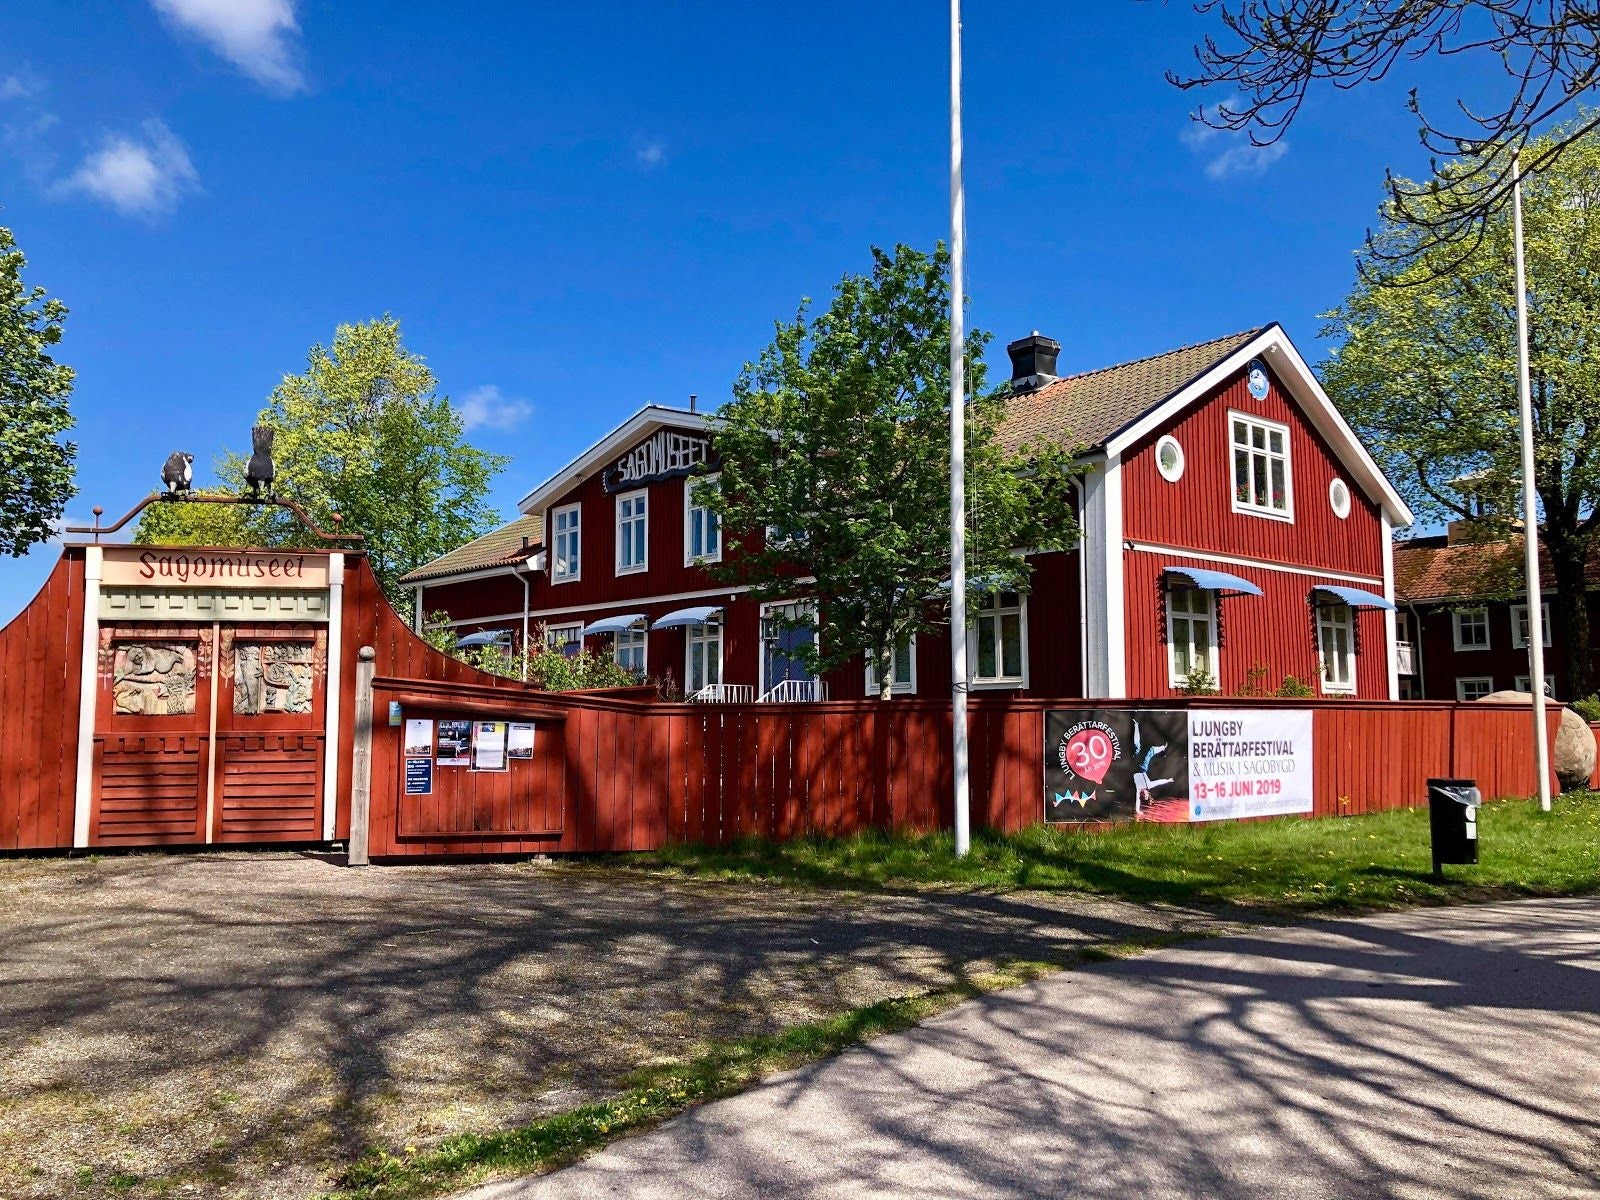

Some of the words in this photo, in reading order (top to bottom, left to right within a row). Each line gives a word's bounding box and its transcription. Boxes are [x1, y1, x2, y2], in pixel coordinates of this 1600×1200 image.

[617, 430, 710, 482] SAGOMUSEET
[139, 550, 306, 583] Sagomuseet
[1063, 720, 1122, 761] BERÄTTARFESTIVAL
[1192, 720, 1243, 737] LJUNGBY
[1058, 739, 1076, 781] LJUNGBY
[1070, 735, 1108, 767] 30
[1193, 738, 1294, 758] BERÄTTARFESTIVAL
[1192, 762, 1201, 777] &
[1203, 761, 1235, 777] MUSIK
[1243, 758, 1296, 775] SAGOBYGD
[1228, 779, 1254, 797] JUNI
[1255, 778, 1281, 796] 2019
